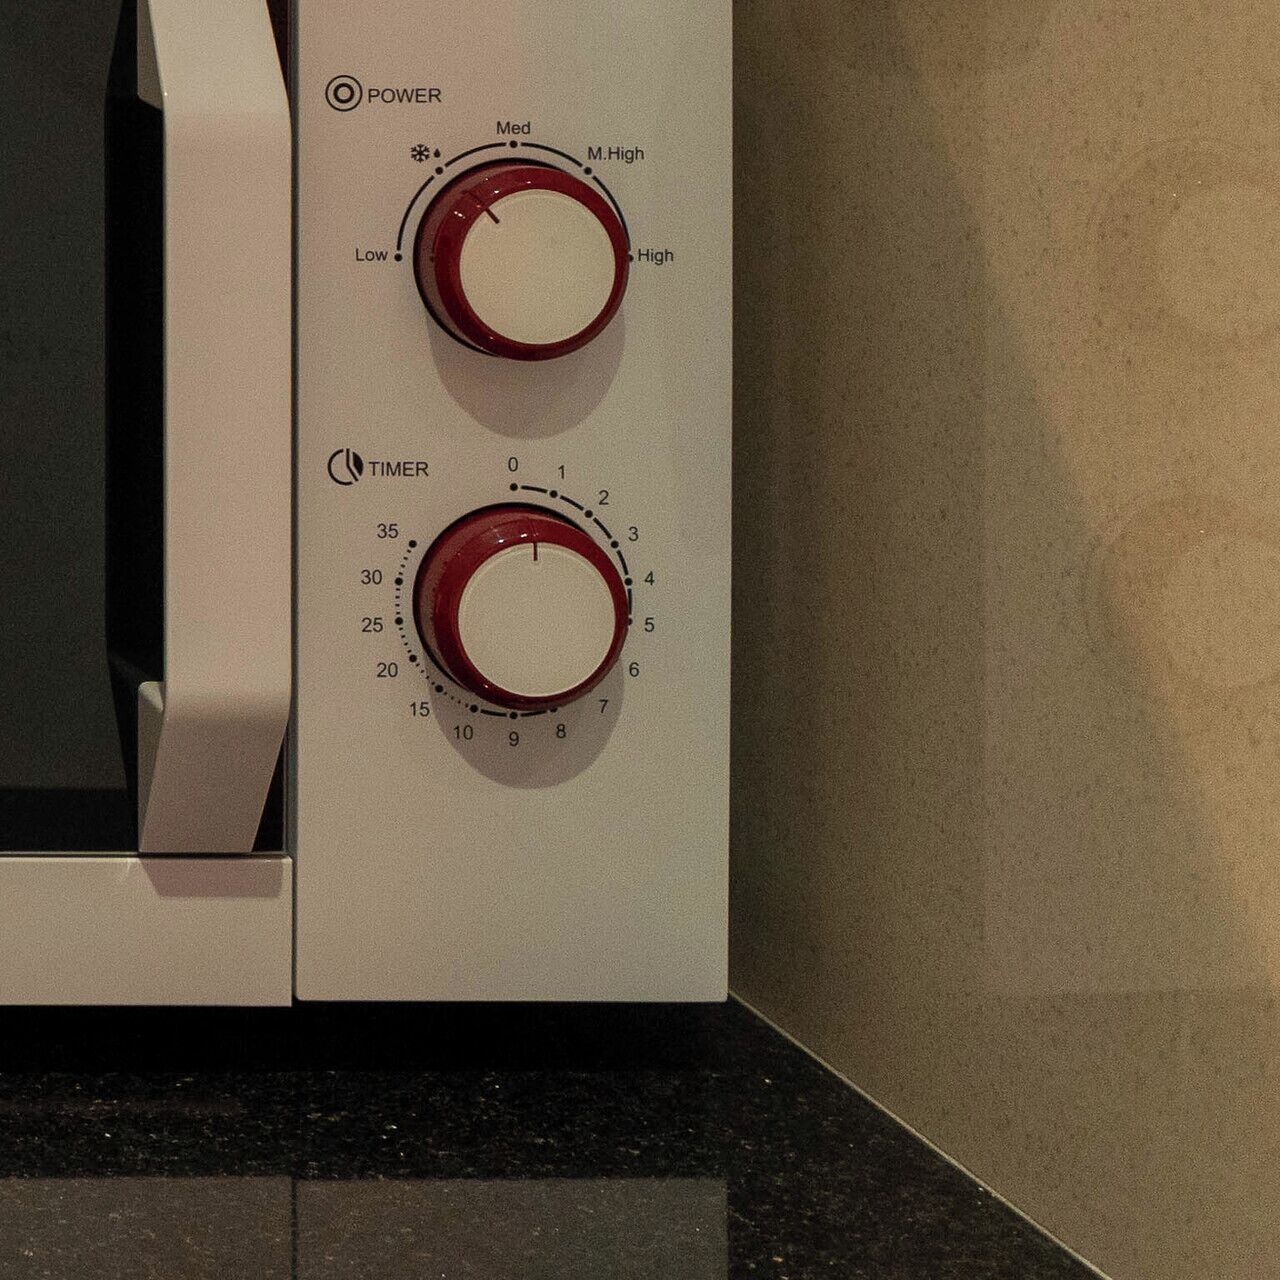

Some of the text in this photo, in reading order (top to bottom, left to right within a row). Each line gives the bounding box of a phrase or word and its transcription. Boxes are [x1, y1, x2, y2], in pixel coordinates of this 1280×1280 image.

[368, 88, 442, 103] POWER
[496, 121, 531, 135] Med
[587, 146, 644, 162] M.High
[355, 248, 388, 262] Low
[638, 248, 674, 264] High
[368, 461, 429, 477] TIMER
[508, 457, 518, 472] 0
[558, 465, 566, 479] 1
[599, 490, 609, 505] 2
[377, 523, 399, 539] 35
[629, 527, 639, 542] 3
[361, 570, 382, 585] 30
[644, 571, 655, 586] 4
[361, 617, 383, 633] 25
[644, 618, 655, 633] 5
[377, 663, 398, 678] 20
[629, 663, 639, 678] 6
[410, 702, 429, 717] 15
[599, 699, 609, 714] 7
[454, 725, 473, 740] 10
[508, 731, 519, 746] 9
[556, 724, 567, 739] 8
